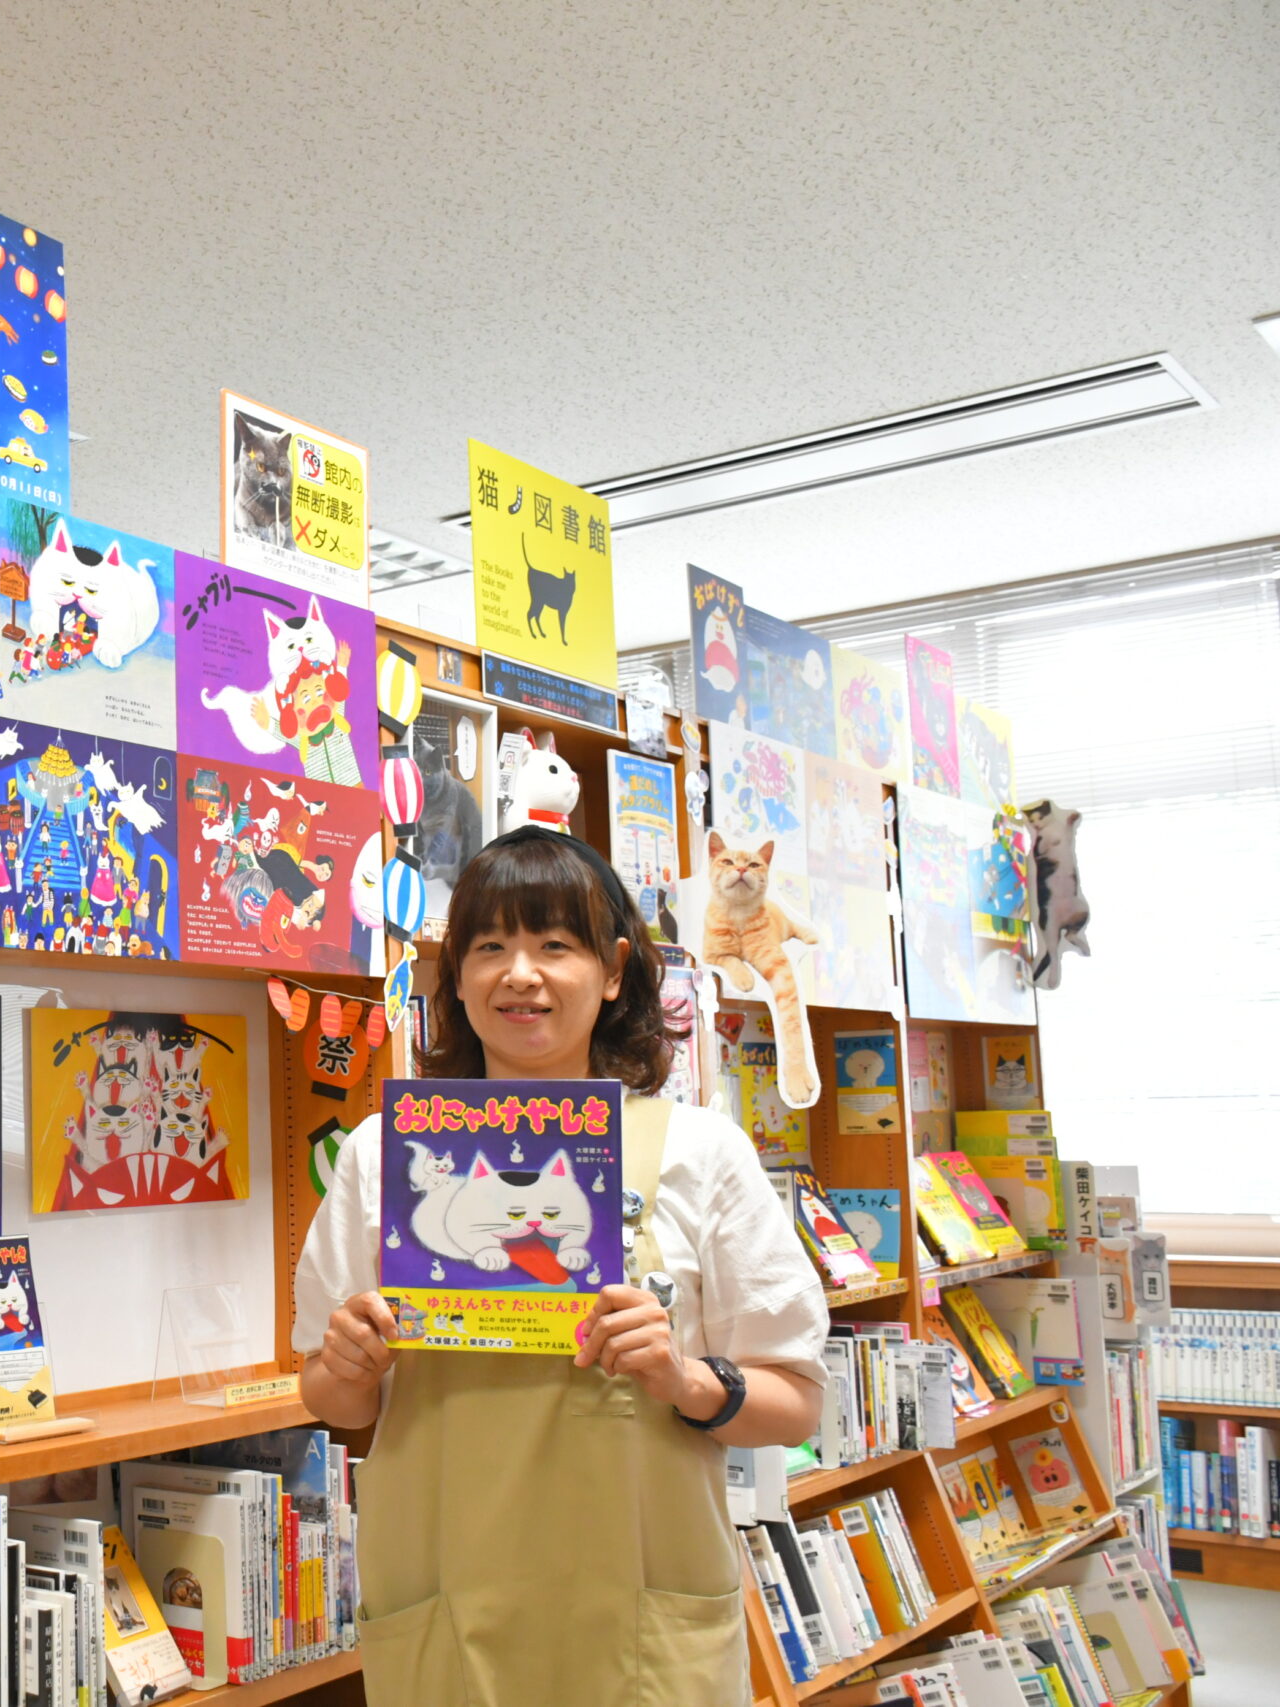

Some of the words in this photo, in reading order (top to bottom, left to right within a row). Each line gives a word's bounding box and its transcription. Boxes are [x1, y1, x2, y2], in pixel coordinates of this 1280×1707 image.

[324, 460, 363, 494] 館内の
[317, 1033, 356, 1075] 祭
[394, 1092, 610, 1136] おにゃけやしき
[1075, 1166, 1093, 1236] 柴田ケイコ
[427, 1296, 507, 1312] ゆうえんちで
[511, 1298, 589, 1314] だいにんき!
